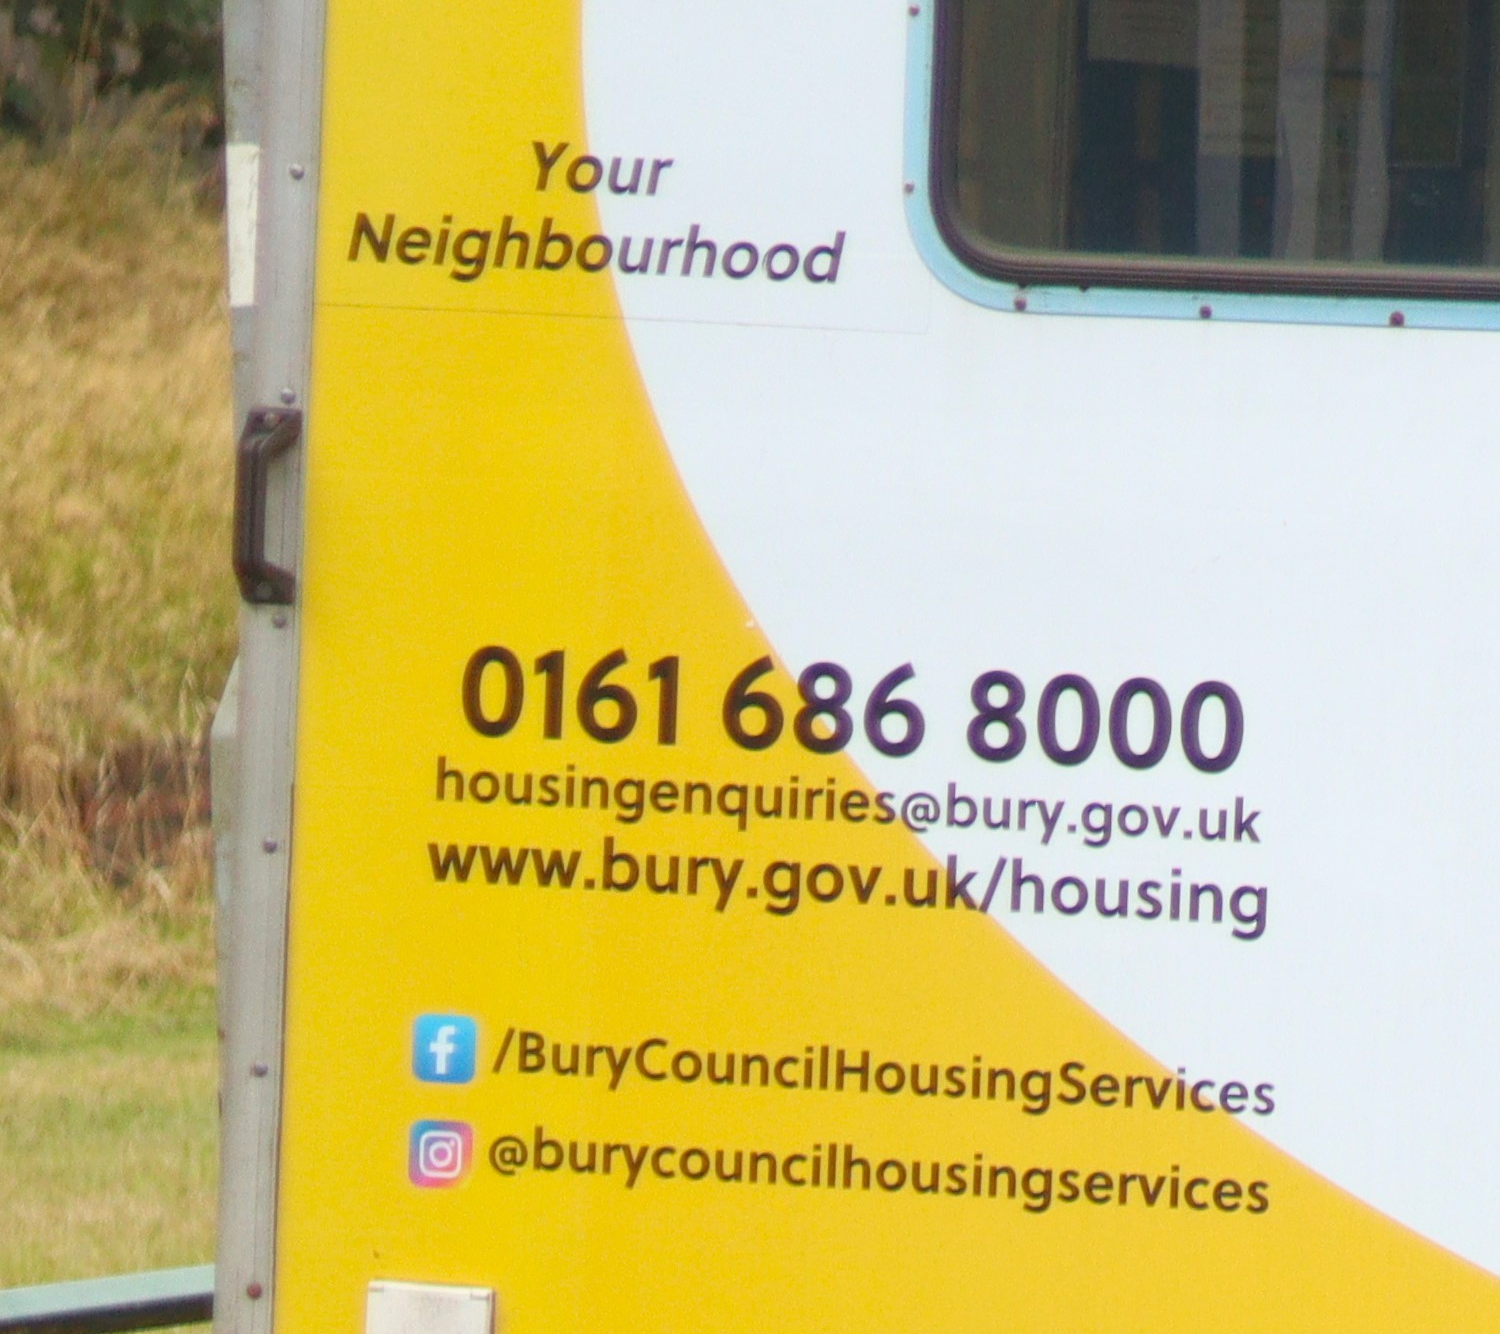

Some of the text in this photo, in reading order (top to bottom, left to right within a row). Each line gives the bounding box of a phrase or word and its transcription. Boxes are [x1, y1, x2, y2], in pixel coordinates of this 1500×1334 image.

[531, 141, 674, 196] Your
[347, 212, 847, 285] Neighbourhood
[460, 644, 1245, 774] 0161 686 8000
[435, 757, 1261, 848] housingenquiries@bury.gov.uk
[428, 837, 1270, 940] www.bury.gov.uk/housing
[492, 1027, 1276, 1116] /BuryCouncilHousingServices
[487, 1127, 1271, 1215] @burycouncilhousingservices
